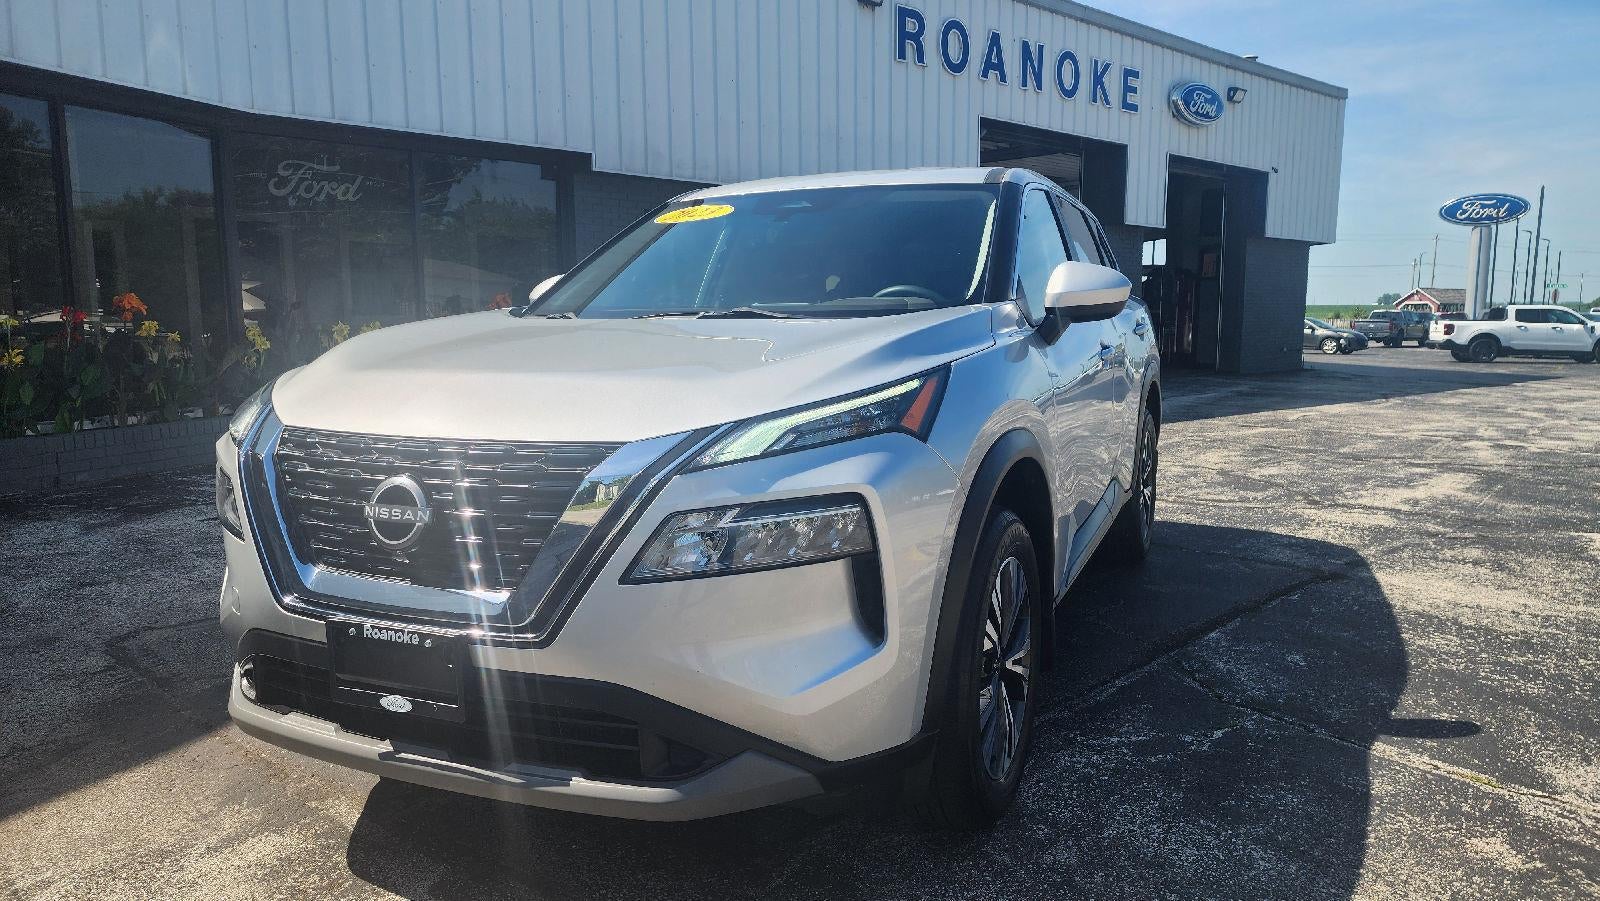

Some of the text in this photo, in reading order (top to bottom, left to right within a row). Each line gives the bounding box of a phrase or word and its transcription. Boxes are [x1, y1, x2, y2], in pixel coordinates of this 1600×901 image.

[896, 4, 1141, 113] ROANOKE
[1190, 90, 1218, 118] Ford
[268, 159, 364, 201] Ford
[1457, 199, 1510, 219] Ford
[365, 505, 430, 524] NISSAN
[363, 624, 420, 645] Roanoke
